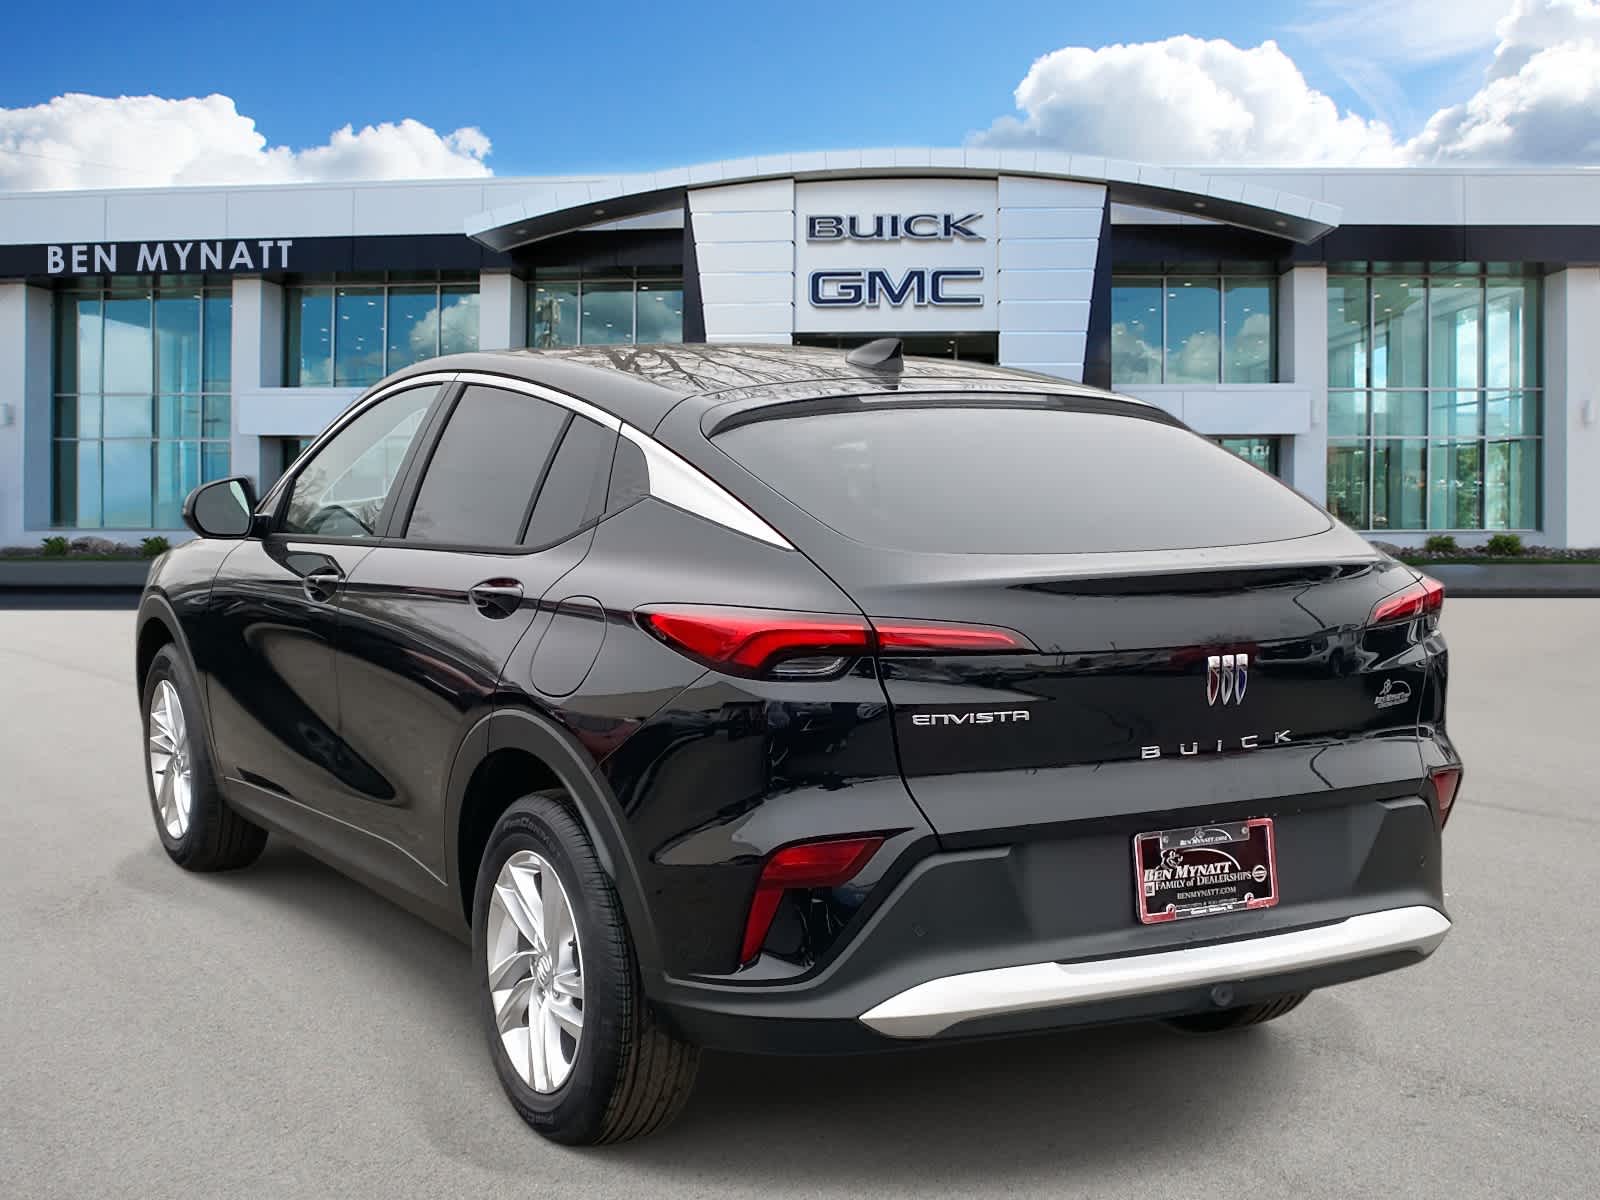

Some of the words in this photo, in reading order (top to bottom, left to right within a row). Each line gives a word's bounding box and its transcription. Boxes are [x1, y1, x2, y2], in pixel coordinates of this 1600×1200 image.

[806, 213, 987, 242] BUICK
[47, 244, 117, 274] BEN
[136, 240, 293, 272] MYNATT
[808, 266, 985, 308] GMC
[911, 710, 1030, 726] ENVISTA
[1140, 728, 1292, 761] BUICK
[1144, 868, 1173, 882] BEN
[1175, 861, 1232, 880] MYNATT
[1155, 878, 1185, 891] FAMILY
[1186, 878, 1195, 887] of
[1196, 871, 1252, 886] DEALERSHIPS
